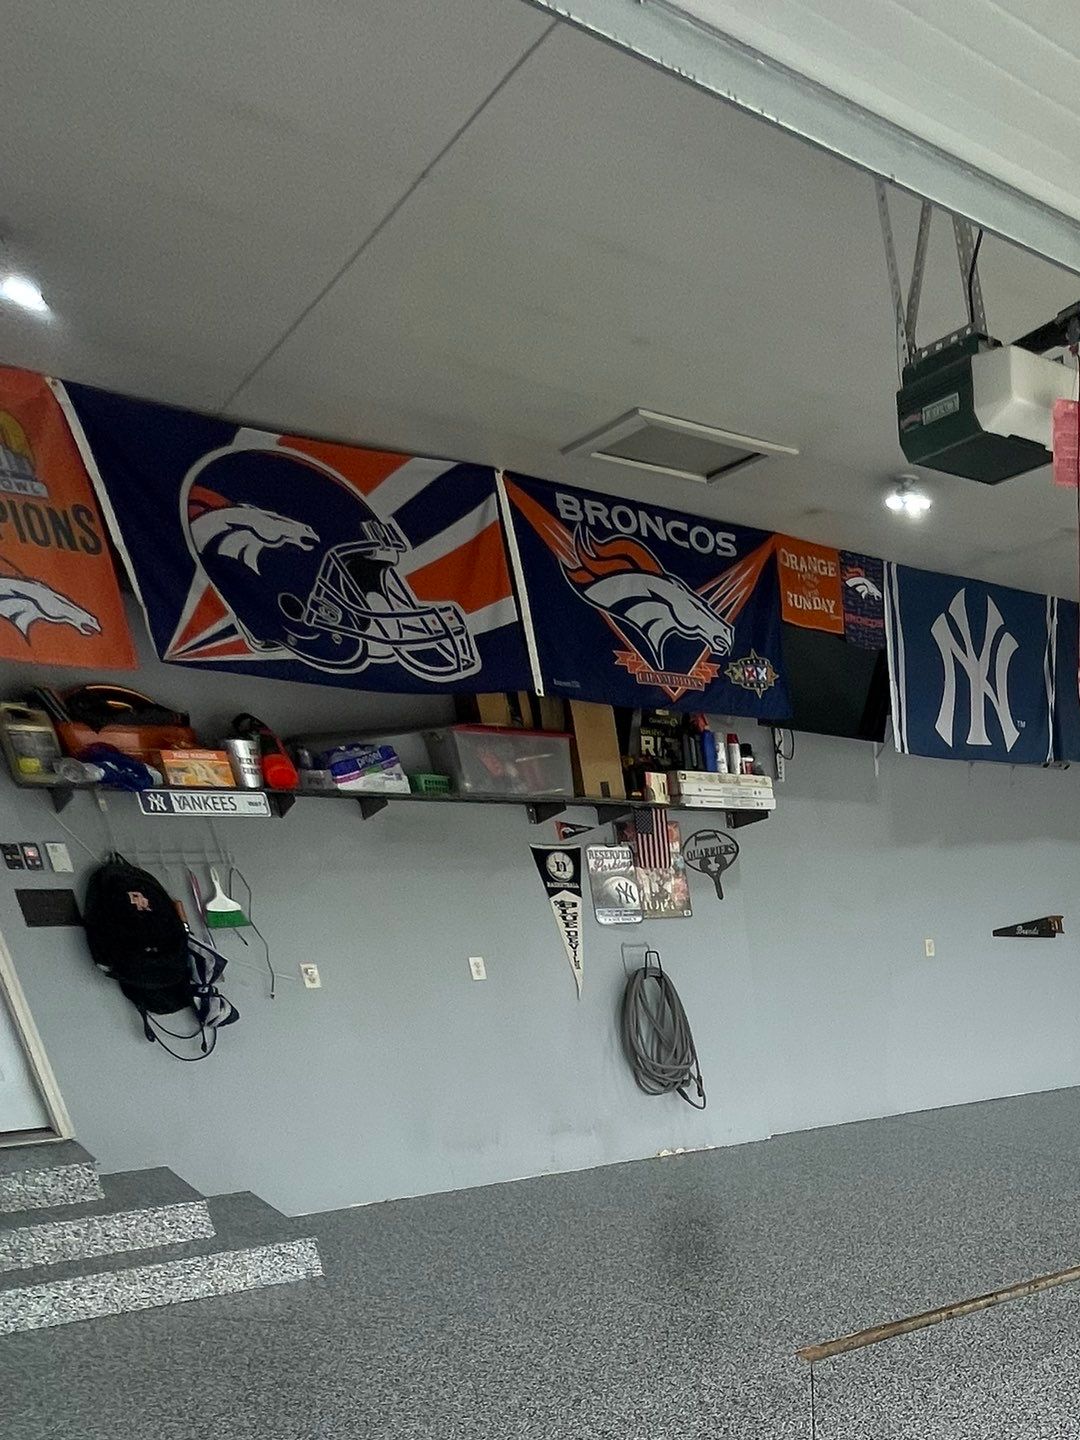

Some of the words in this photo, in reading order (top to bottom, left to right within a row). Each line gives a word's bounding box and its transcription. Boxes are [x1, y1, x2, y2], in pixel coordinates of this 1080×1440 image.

[555, 492, 738, 558] BRONCOS
[780, 548, 838, 577] ORANGE
[637, 672, 705, 689] CHAMPIONS
[173, 795, 237, 812] YANKEES
[588, 850, 632, 860] RESERVED
[686, 844, 735, 860] QUARRIERS
